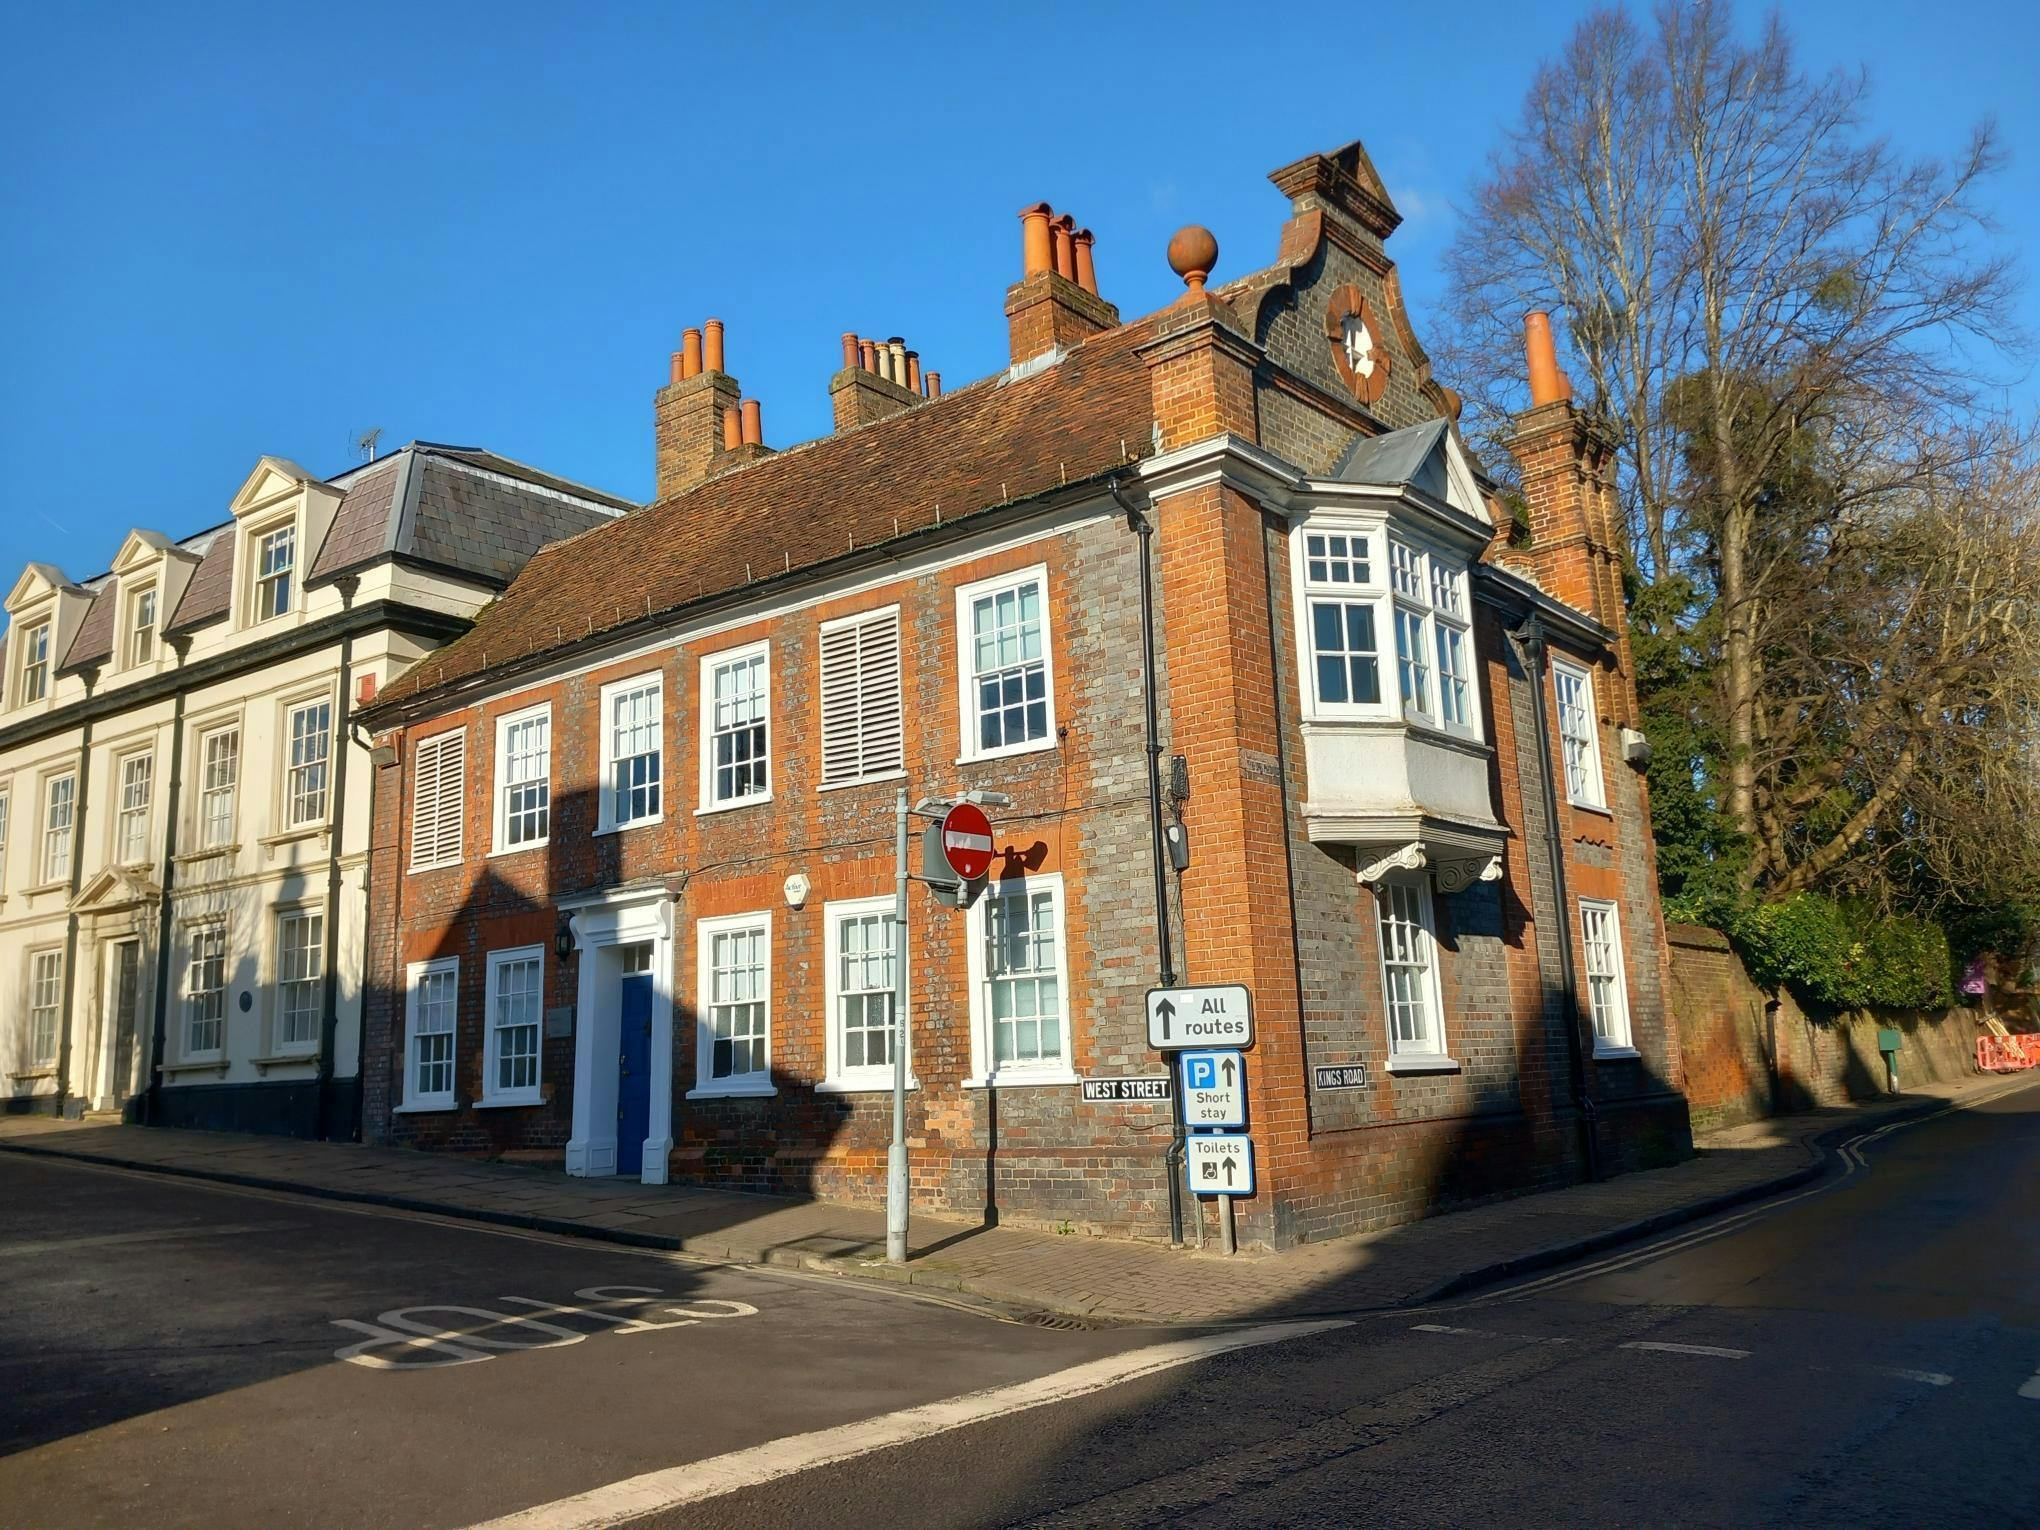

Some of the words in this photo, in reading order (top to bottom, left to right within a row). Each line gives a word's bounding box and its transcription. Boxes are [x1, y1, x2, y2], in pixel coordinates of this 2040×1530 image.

[1201, 998, 1226, 1014] All
[1185, 1019, 1244, 1035] routes
[1193, 1062, 1211, 1087] P
[1318, 1070, 1342, 1087] KINGS
[1343, 1069, 1364, 1085] ROAD
[1085, 1081, 1117, 1098] WEST
[1121, 1081, 1167, 1098] STREET
[1196, 1092, 1230, 1104] Short
[1200, 1108, 1226, 1120] stay
[1195, 1141, 1240, 1154] Toilets
